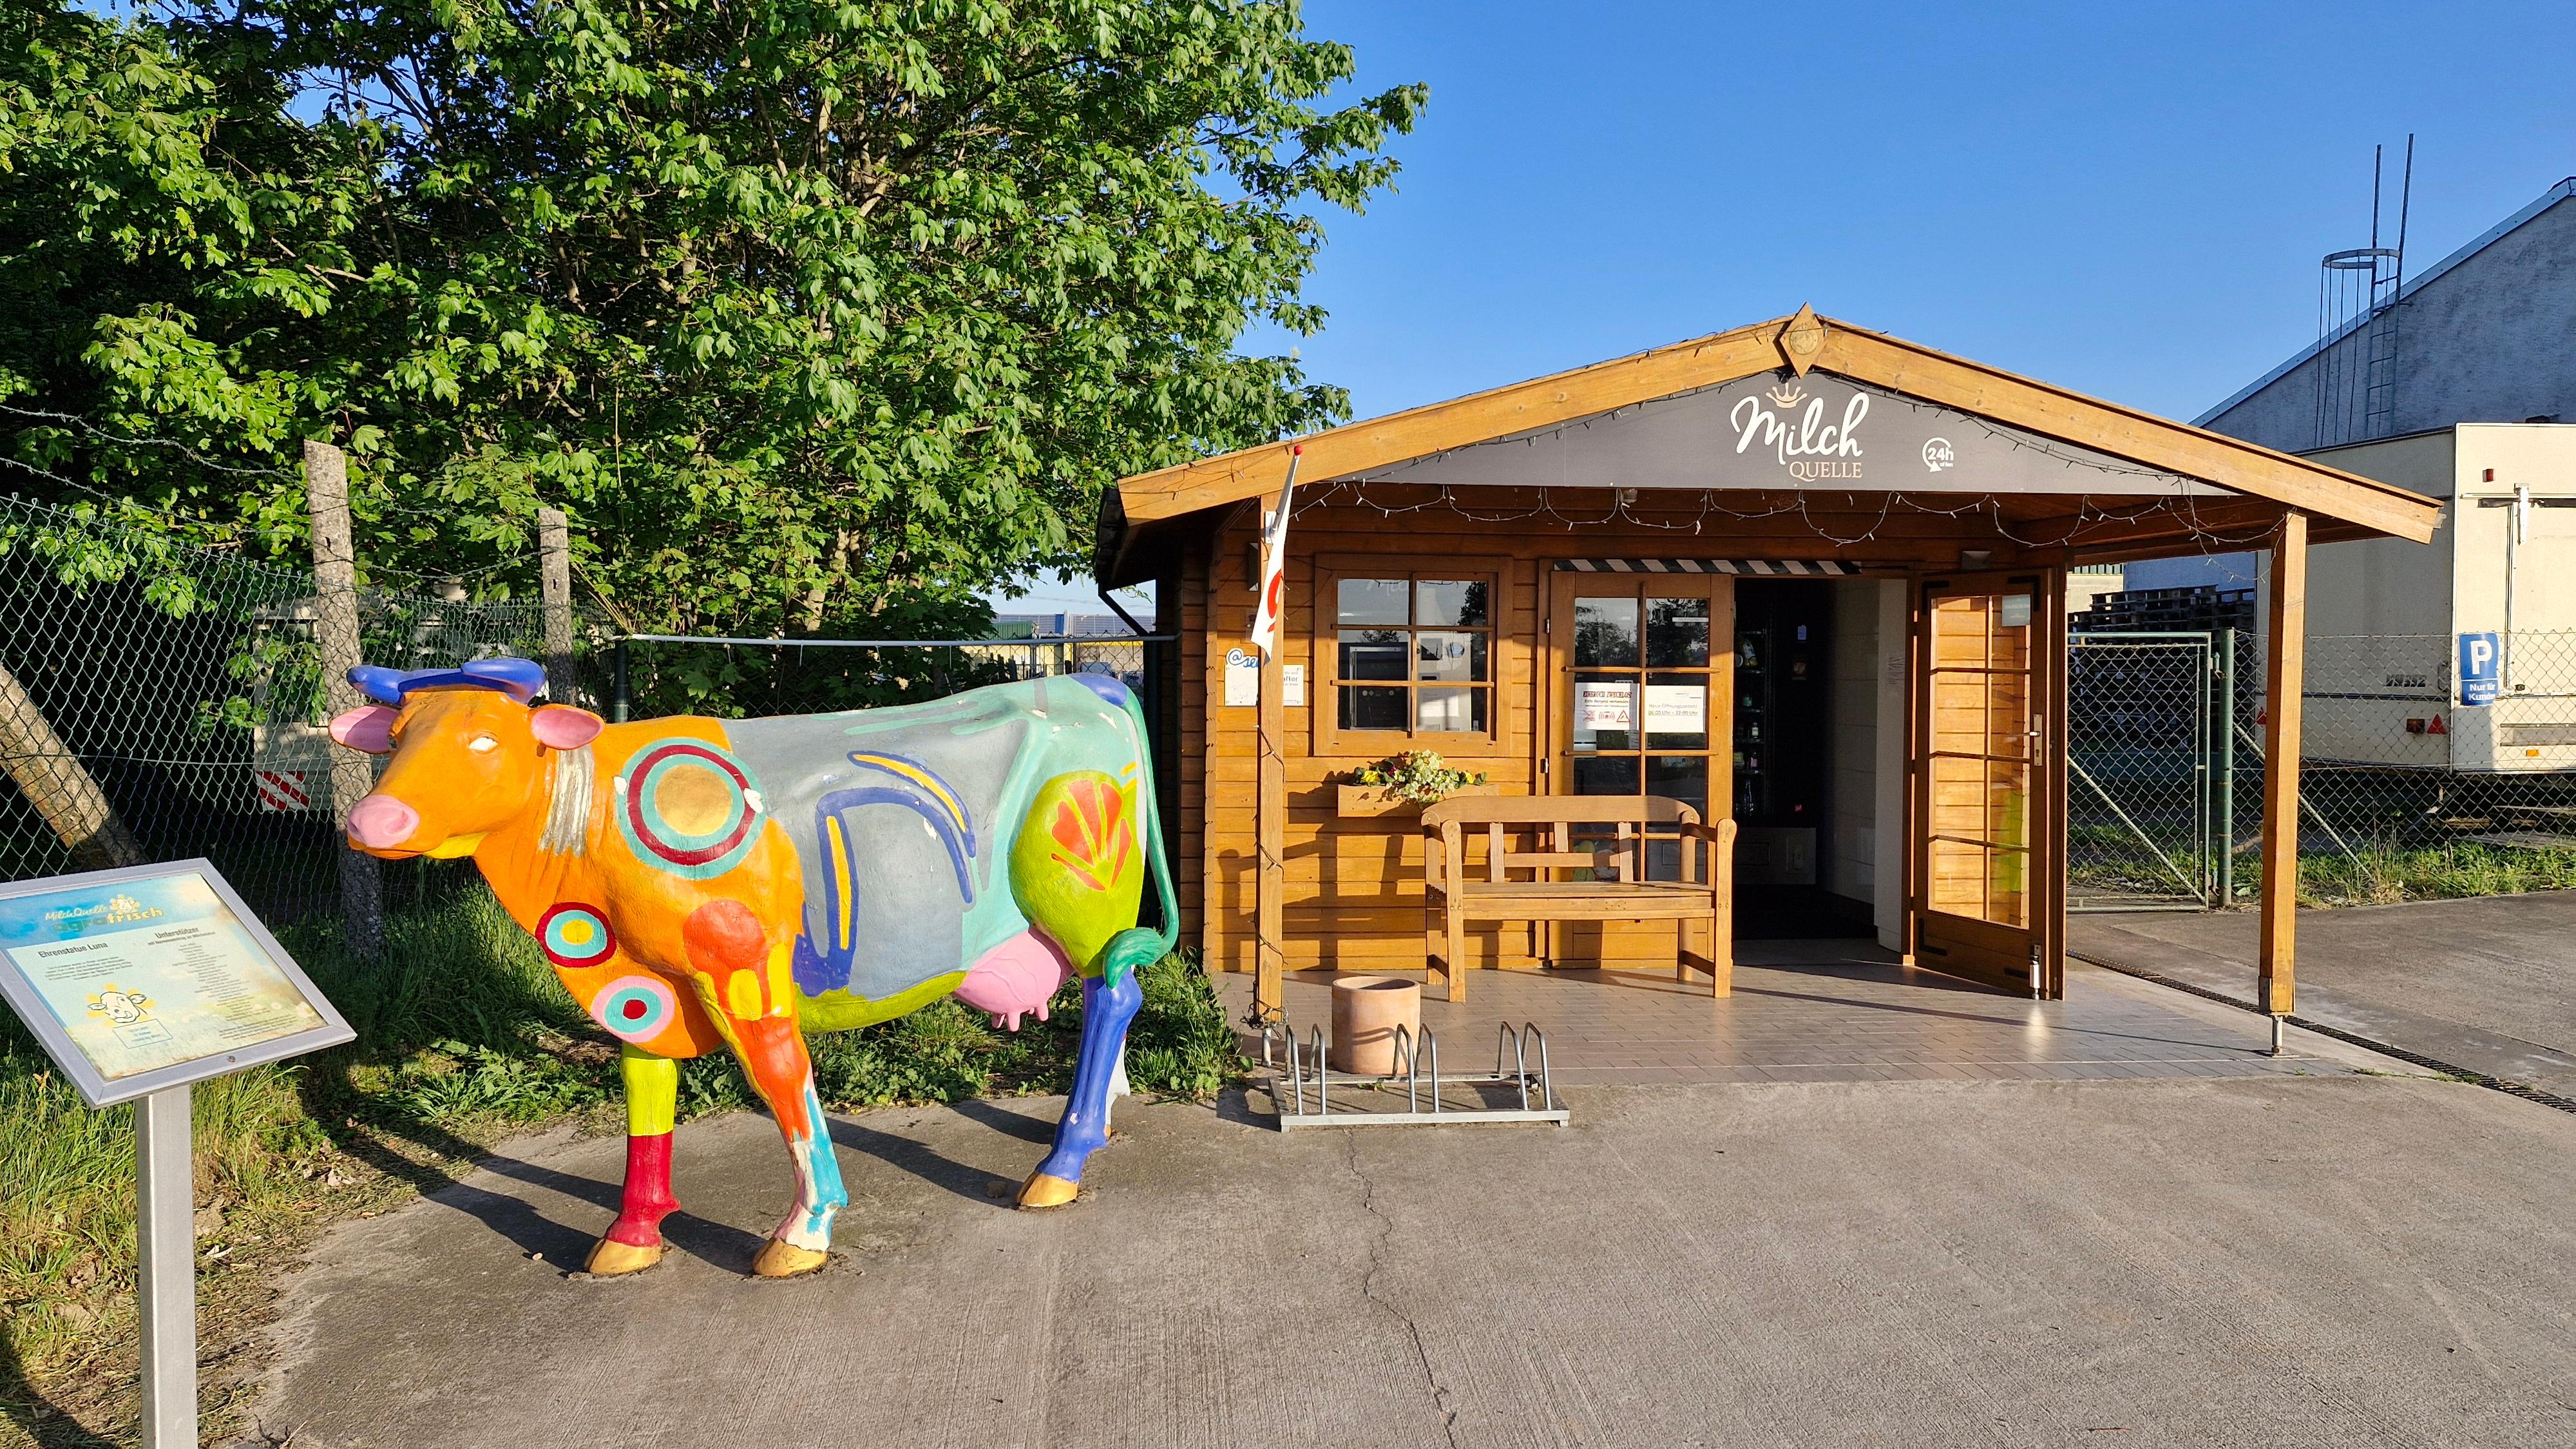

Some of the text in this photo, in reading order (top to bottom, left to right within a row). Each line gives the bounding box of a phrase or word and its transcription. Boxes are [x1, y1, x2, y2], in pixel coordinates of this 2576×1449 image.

[1730, 392, 1869, 465] Milch
[1927, 446, 1954, 461] 24h
[1789, 461, 1862, 482] QUELLE
[2469, 640, 2493, 675] P
[2469, 682, 2496, 691] Nur für
[155, 927, 200, 939] Unterstützer
[38, 941, 109, 958] Ehrenstatue Luna
